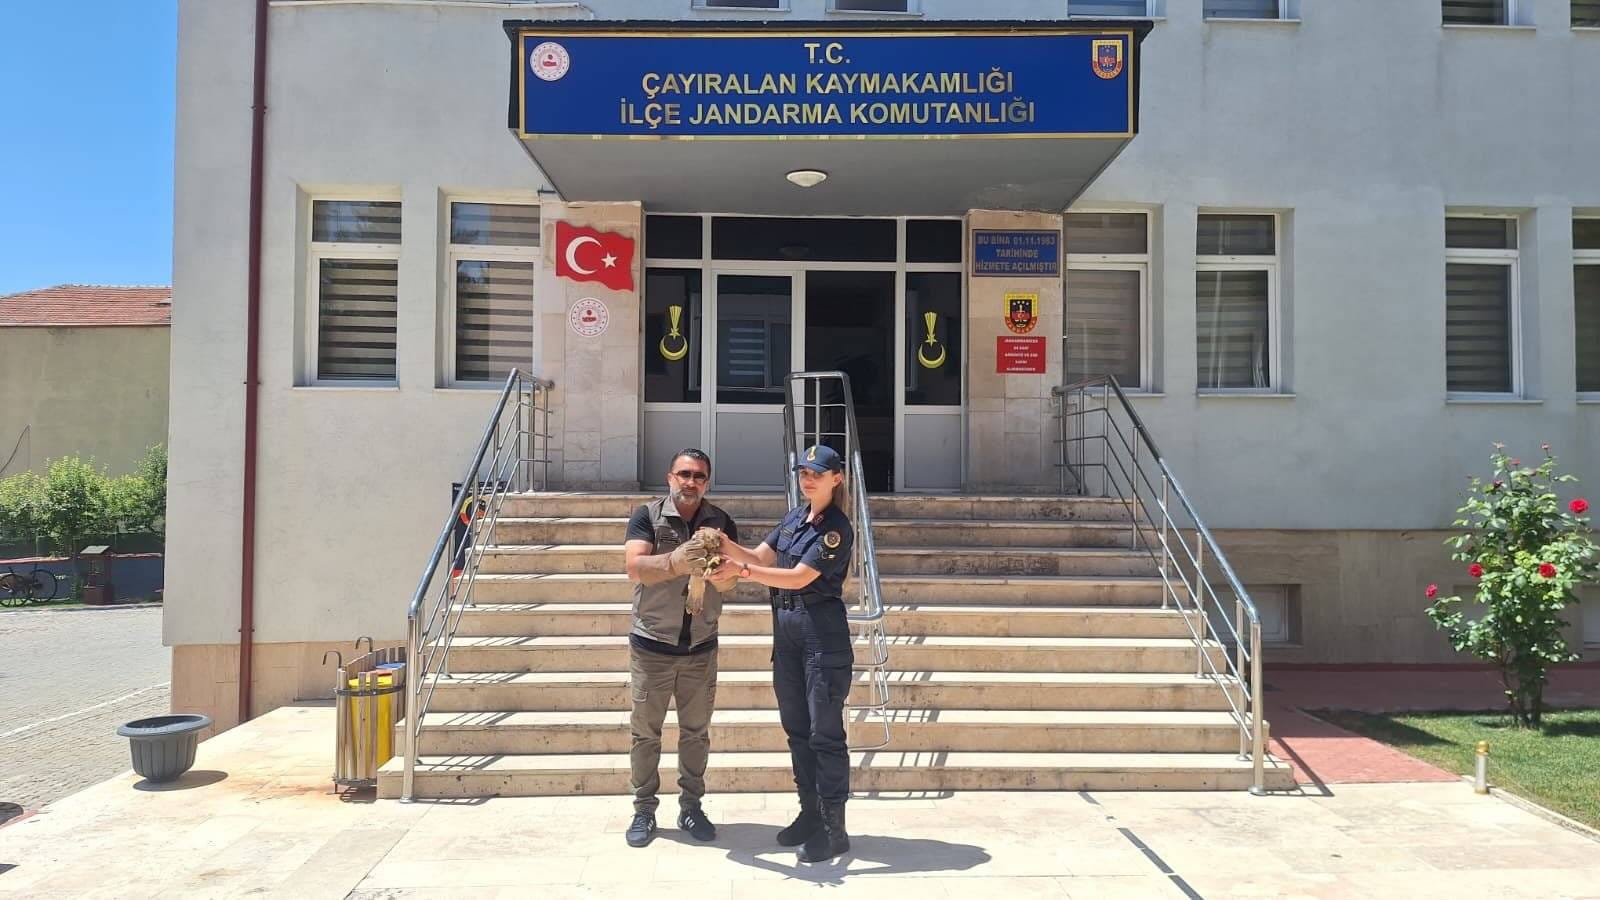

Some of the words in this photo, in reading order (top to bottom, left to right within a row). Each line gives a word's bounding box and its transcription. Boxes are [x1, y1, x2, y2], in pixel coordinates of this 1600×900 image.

[804, 42, 850, 64] T.C.
[642, 73, 796, 98] ÇAYIRALAN
[806, 66, 1013, 95] KAYMAKAMLIĞI
[620, 97, 681, 128] İLÇE
[689, 103, 842, 125] JANDARMA
[850, 96, 1035, 124] KOMUTANLIĞI
